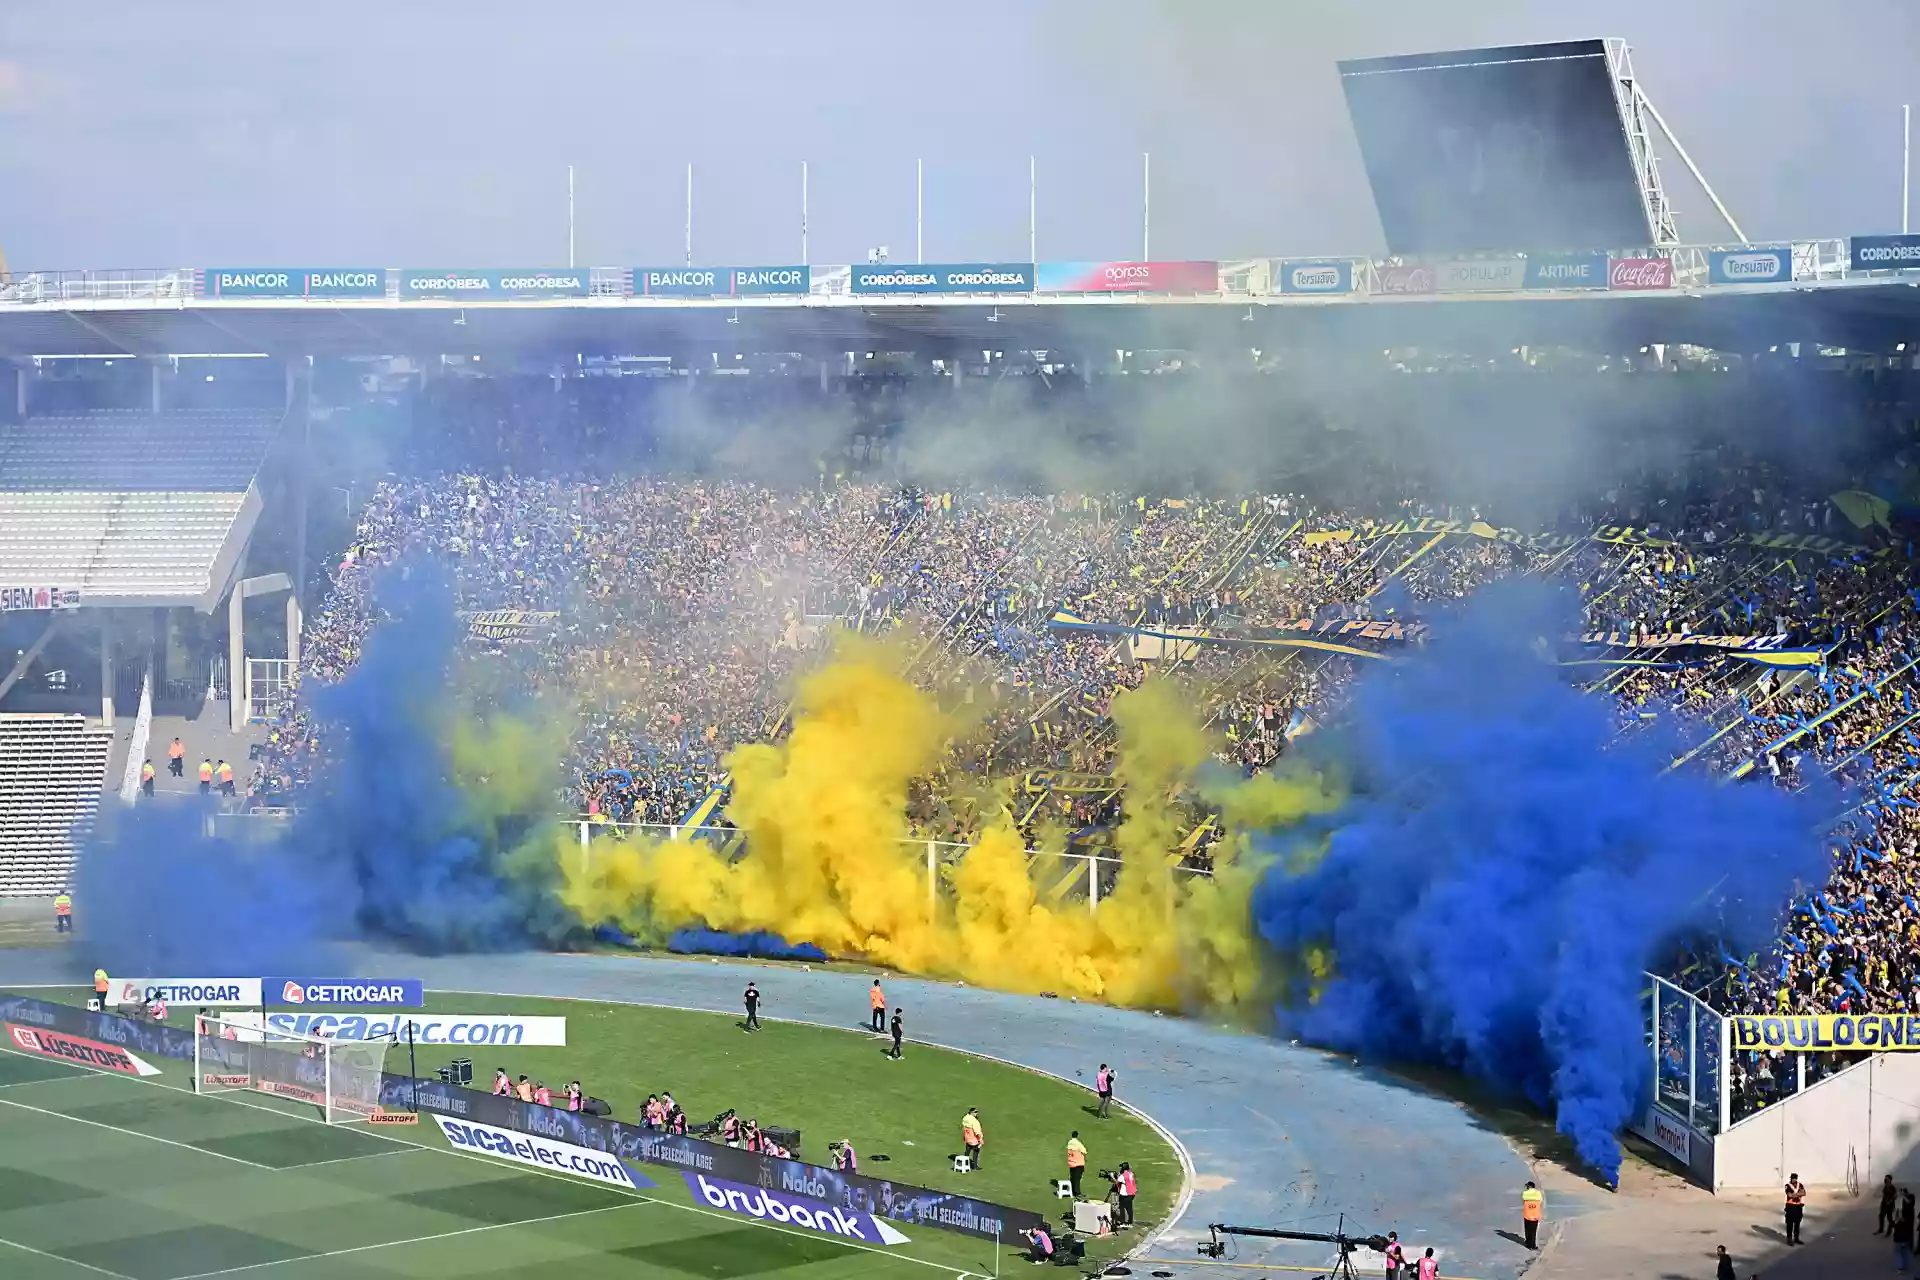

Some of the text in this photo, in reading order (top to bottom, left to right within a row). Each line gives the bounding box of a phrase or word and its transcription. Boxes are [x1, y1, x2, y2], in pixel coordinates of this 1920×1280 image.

[1105, 266, 1149, 281] apross
[1450, 266, 1512, 281] POPULAR
[1537, 264, 1590, 278] ARTIME
[1727, 259, 1775, 273] Tersuave
[221, 273, 377, 287] BANCOR BANCOR
[410, 277, 581, 290] CORDOBESA CORDOBESA
[650, 271, 802, 286] BANCOR BANCOR
[860, 272, 1024, 286] CORDOBESA CORDOBESA
[1296, 271, 1337, 285] Tersuave
[145, 985, 404, 1003] CETROGAR CETROGAR
[1737, 1016, 1920, 1048] BOULOGNE
[528, 1113, 564, 1138] Naldo
[696, 1153, 713, 1170] ARGE
[783, 1171, 826, 1198] Naldo
[698, 1174, 865, 1240] brubank
[929, 1205, 938, 1221] LA
